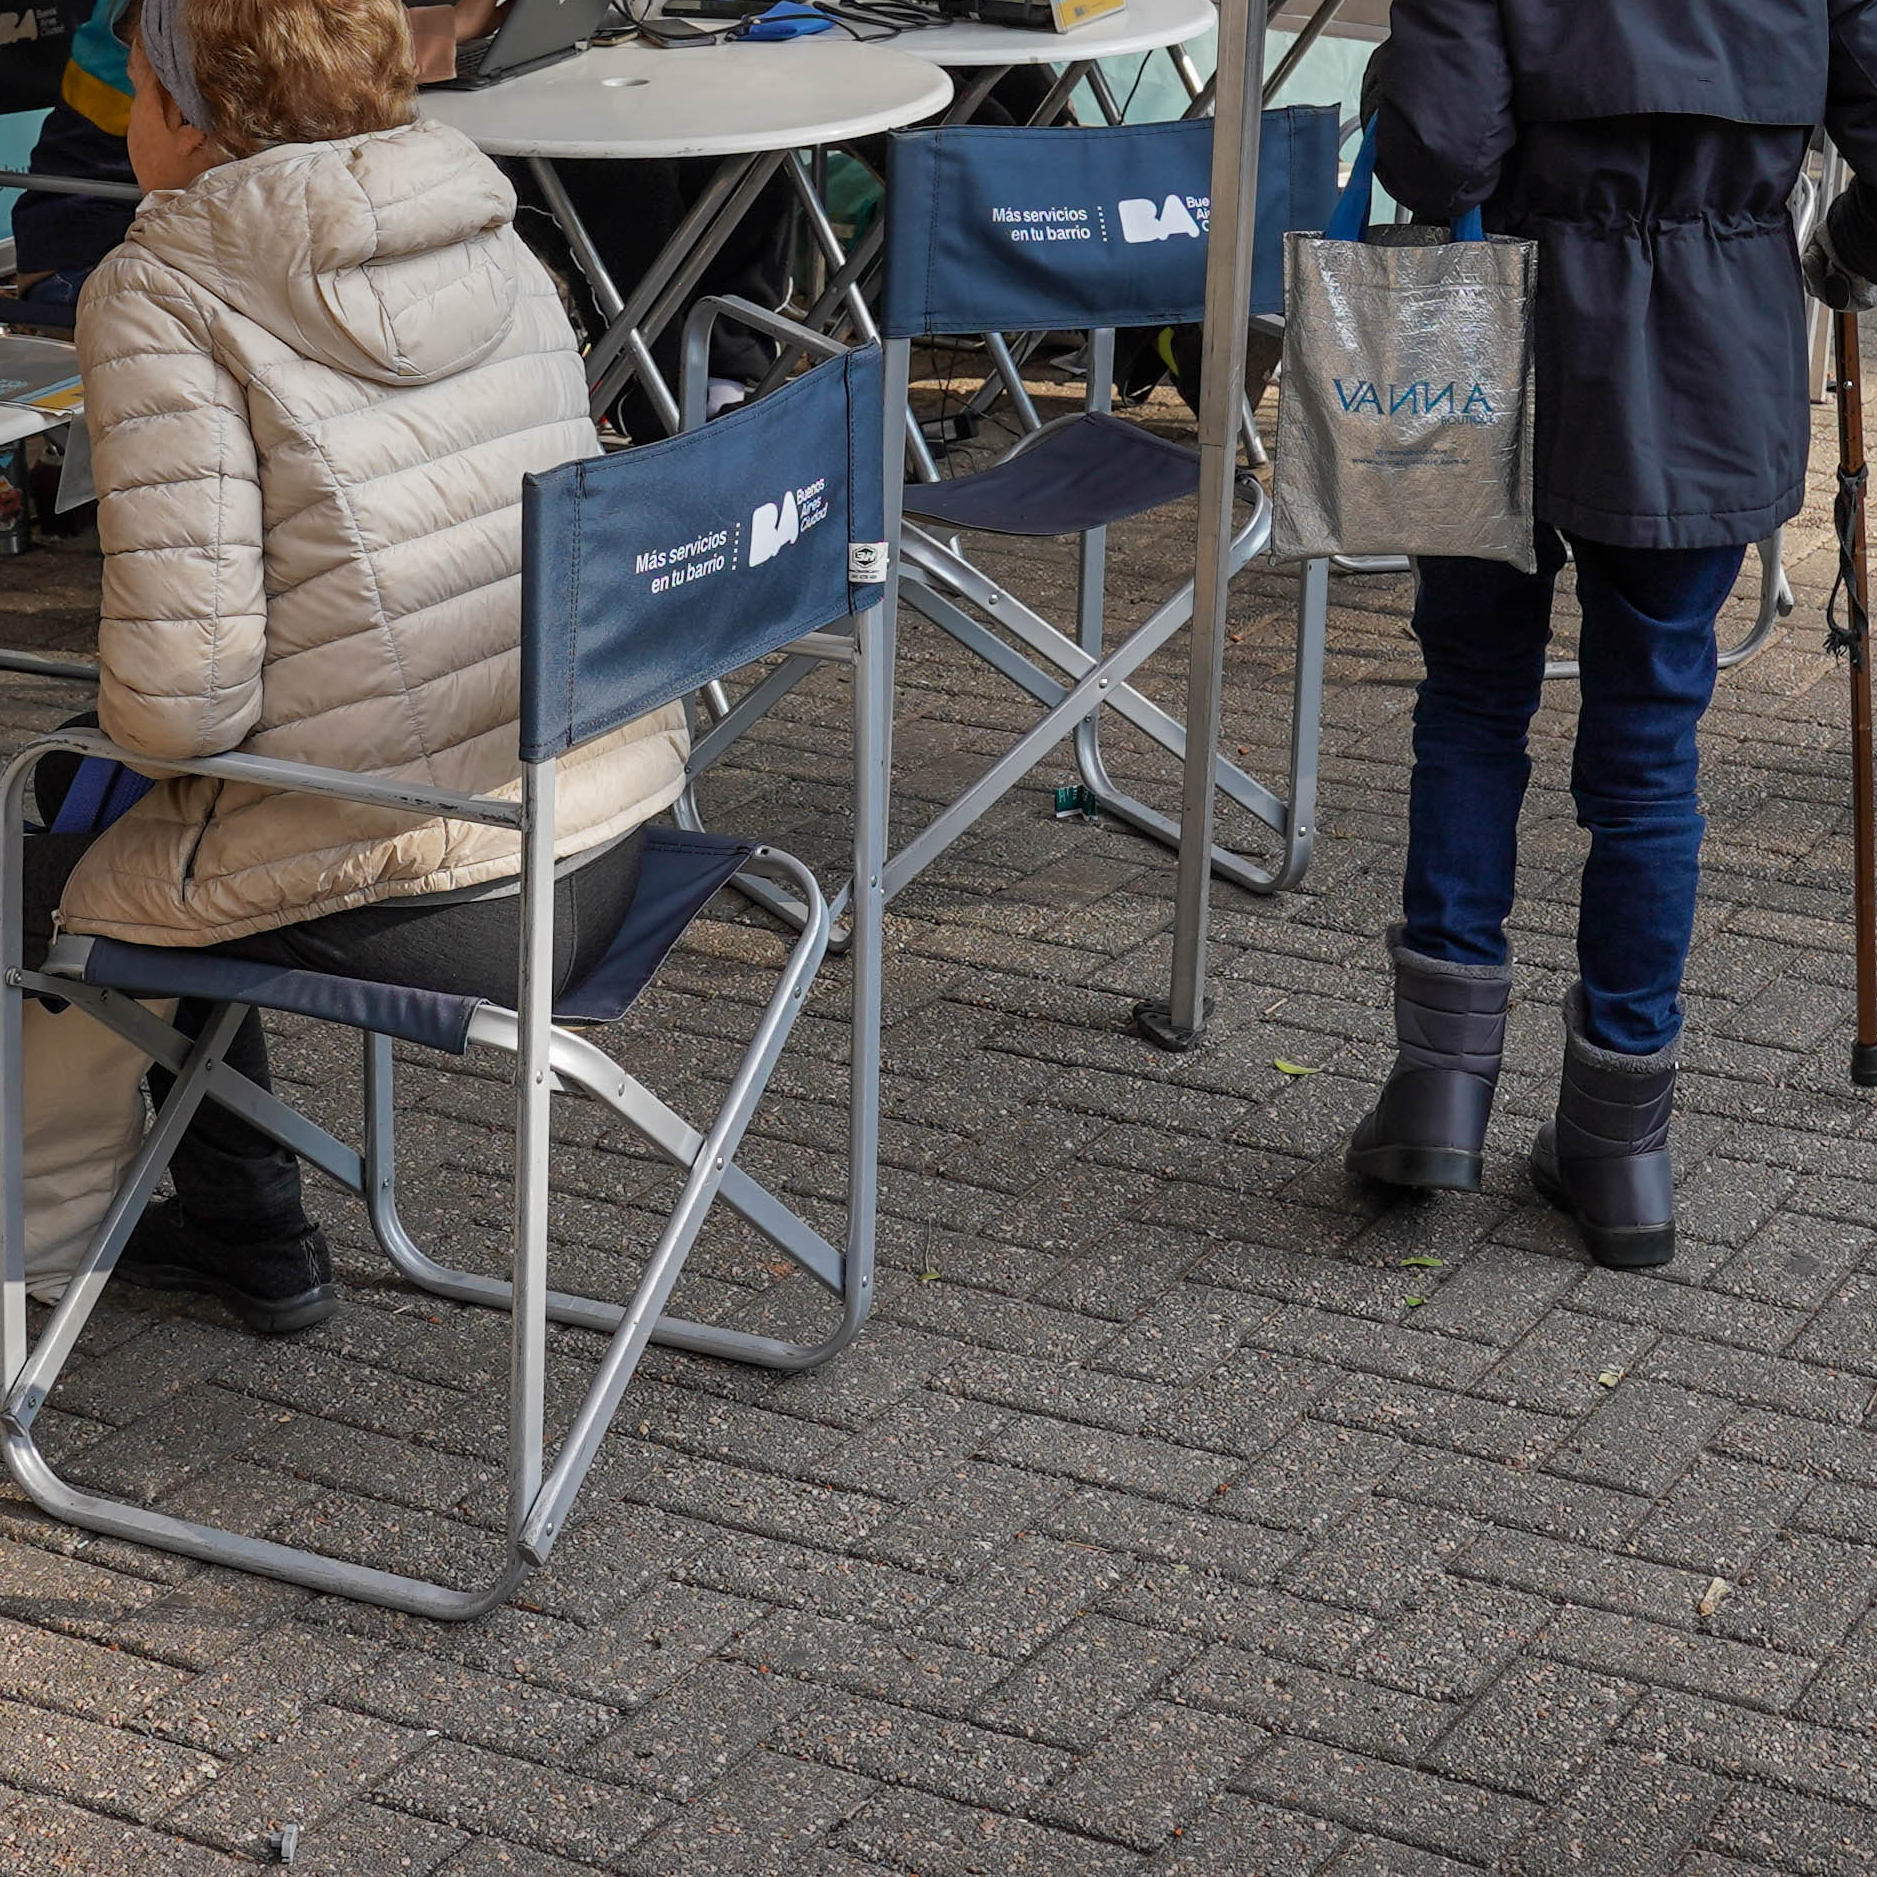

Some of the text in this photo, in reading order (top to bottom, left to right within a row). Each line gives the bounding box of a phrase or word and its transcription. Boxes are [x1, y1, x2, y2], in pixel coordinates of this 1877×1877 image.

[992, 206, 1088, 223] Más servicios
[1118, 194, 1200, 243] BA
[1011, 224, 1091, 242] en tu barrio
[796, 478, 825, 505] Buenos
[800, 497, 822, 519] Aires
[749, 491, 799, 567] BA
[636, 529, 727, 574] Más servicios
[651, 553, 724, 594] en tu barrio
